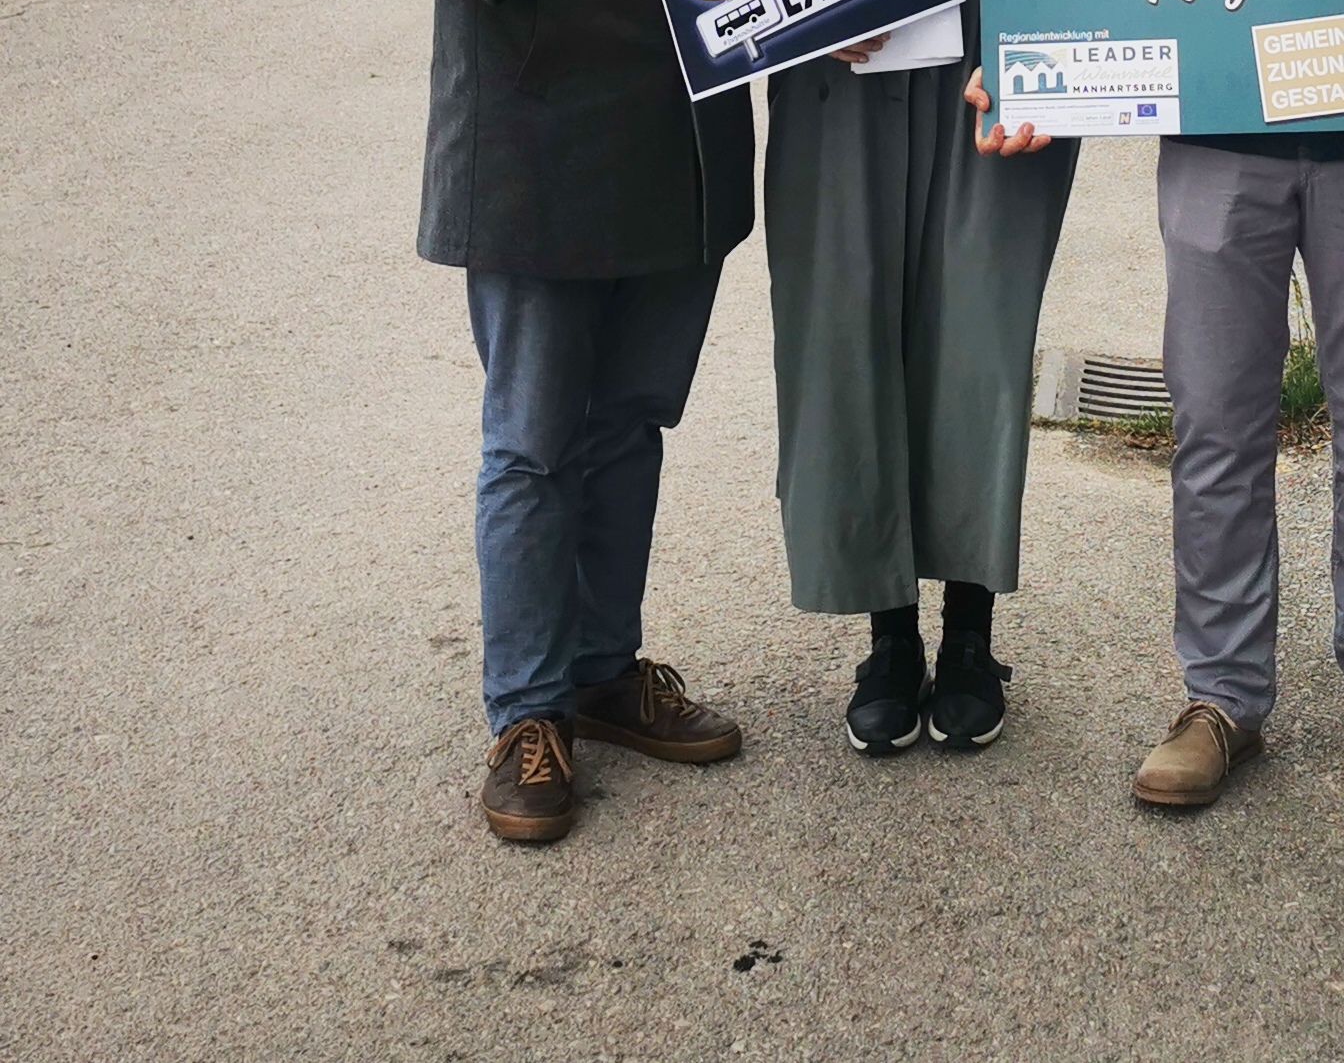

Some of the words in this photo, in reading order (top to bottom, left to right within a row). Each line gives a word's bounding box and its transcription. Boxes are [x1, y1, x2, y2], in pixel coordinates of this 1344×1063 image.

[999, 30, 1093, 43] Regionalentwicklung
[1094, 29, 1110, 39] mit
[1072, 44, 1173, 64] LEADER
[1072, 82, 1174, 94] MANHARTSBERG
